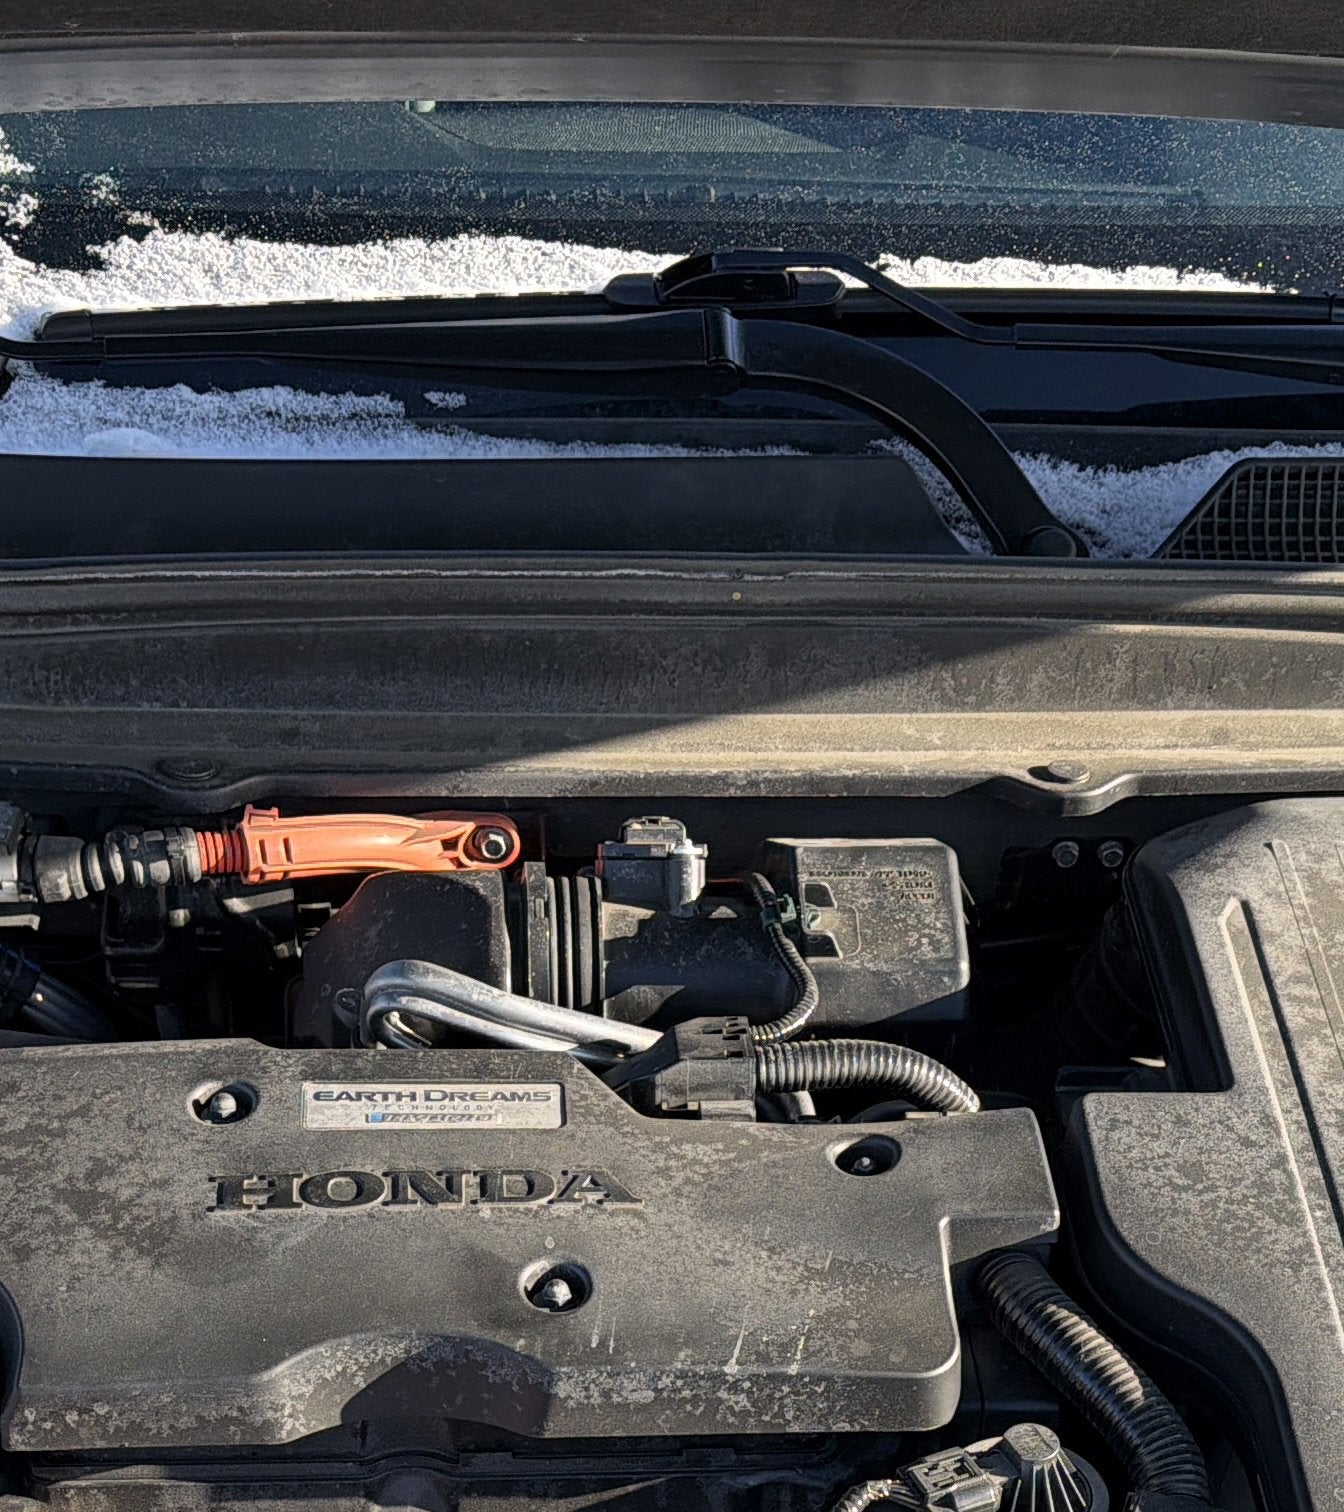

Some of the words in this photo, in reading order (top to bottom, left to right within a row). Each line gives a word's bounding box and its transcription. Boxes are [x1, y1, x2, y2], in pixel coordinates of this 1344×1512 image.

[312, 1090, 417, 1102] EARTH
[423, 1089, 552, 1102] DREAMS
[206, 1169, 644, 1212] HONDA
